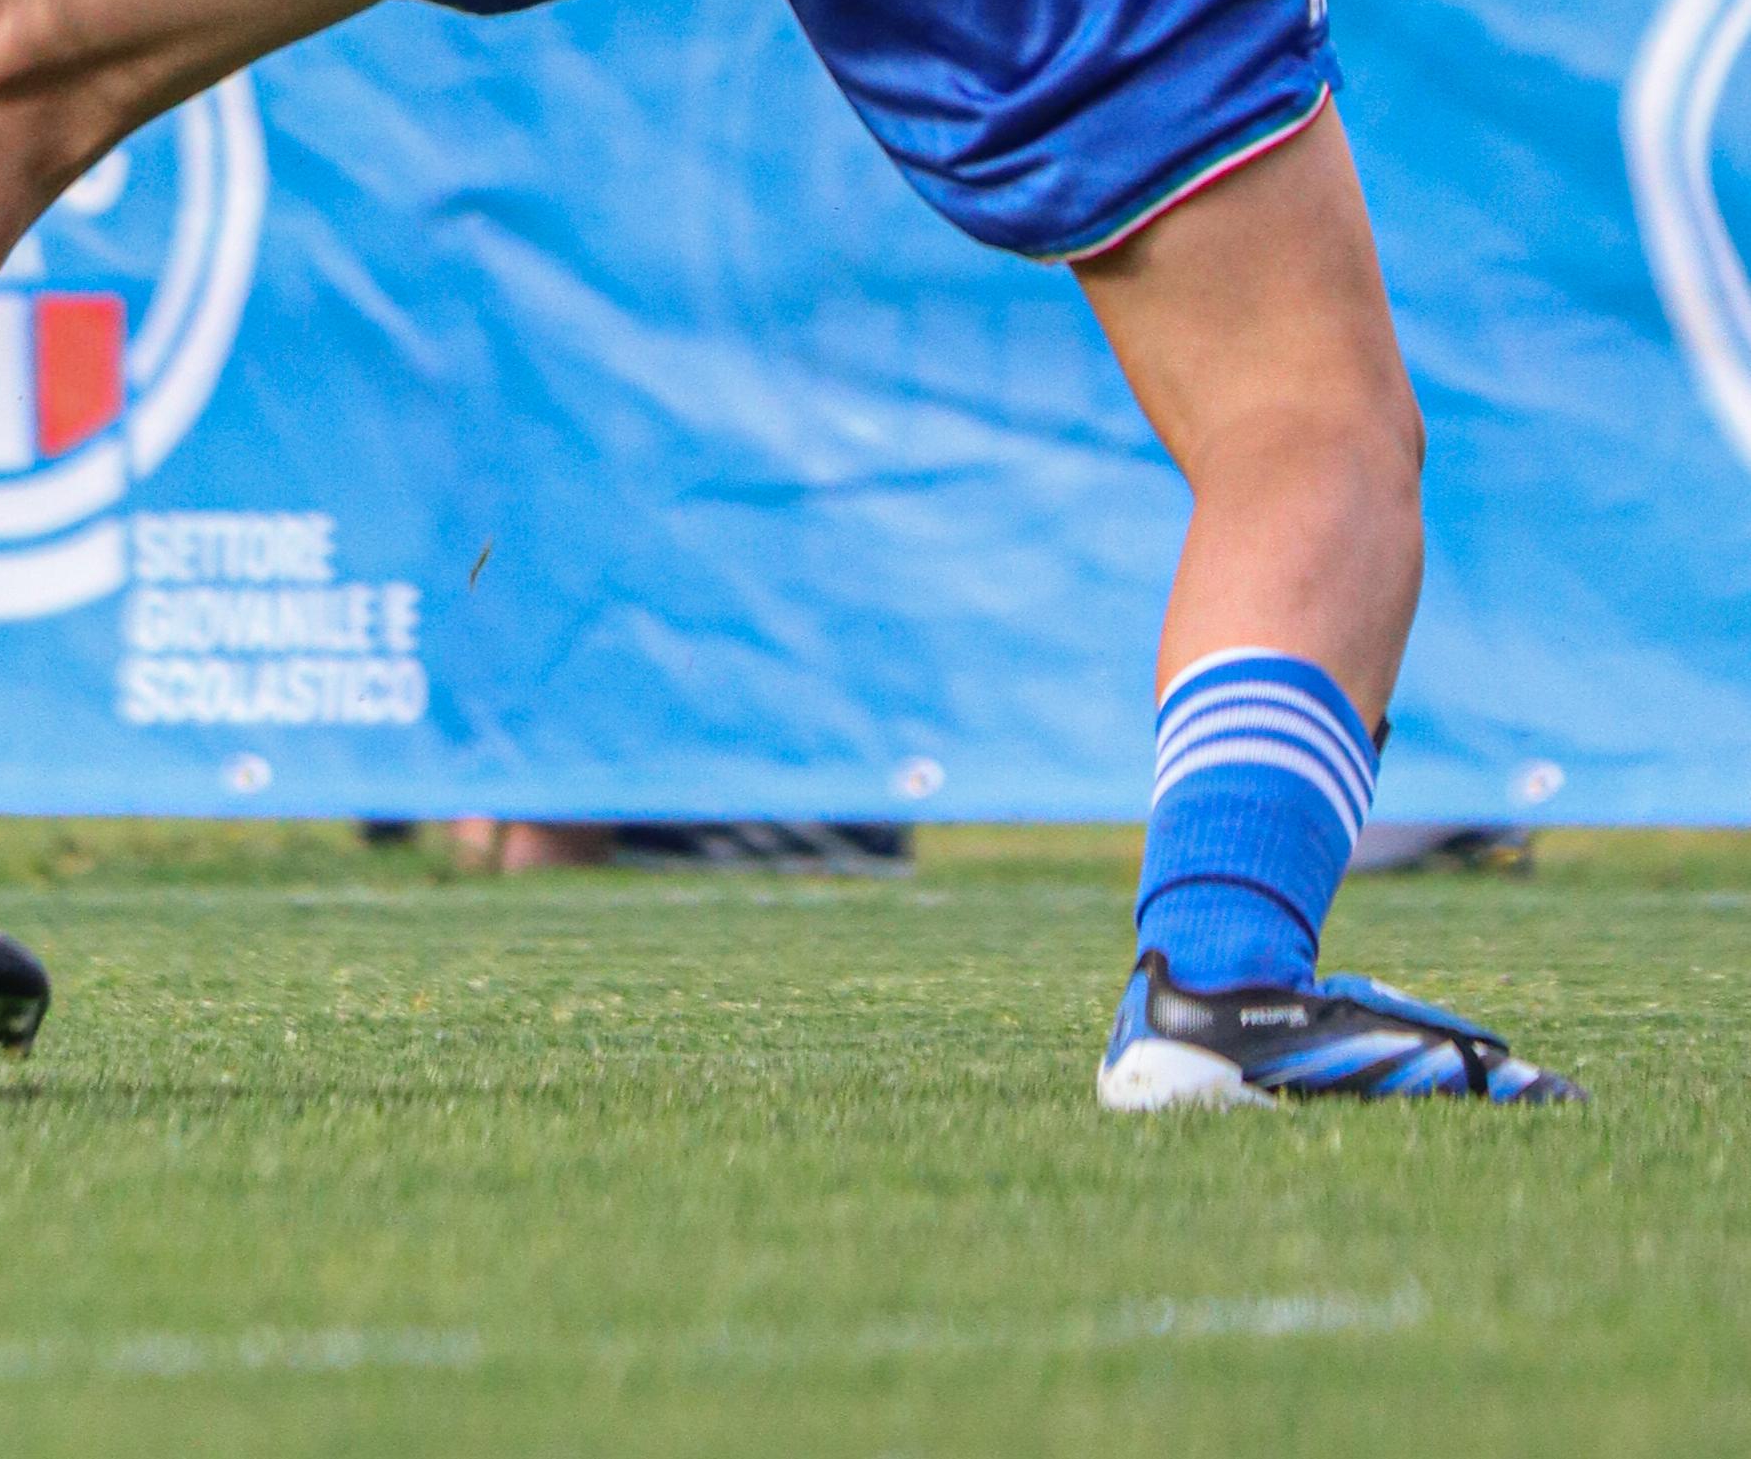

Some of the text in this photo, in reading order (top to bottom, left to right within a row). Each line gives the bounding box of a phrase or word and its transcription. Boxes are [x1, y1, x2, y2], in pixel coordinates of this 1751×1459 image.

[133, 512, 336, 582] SETTORE
[130, 583, 421, 653] GIOVANILE E
[125, 656, 429, 725] SCOLASTICO
